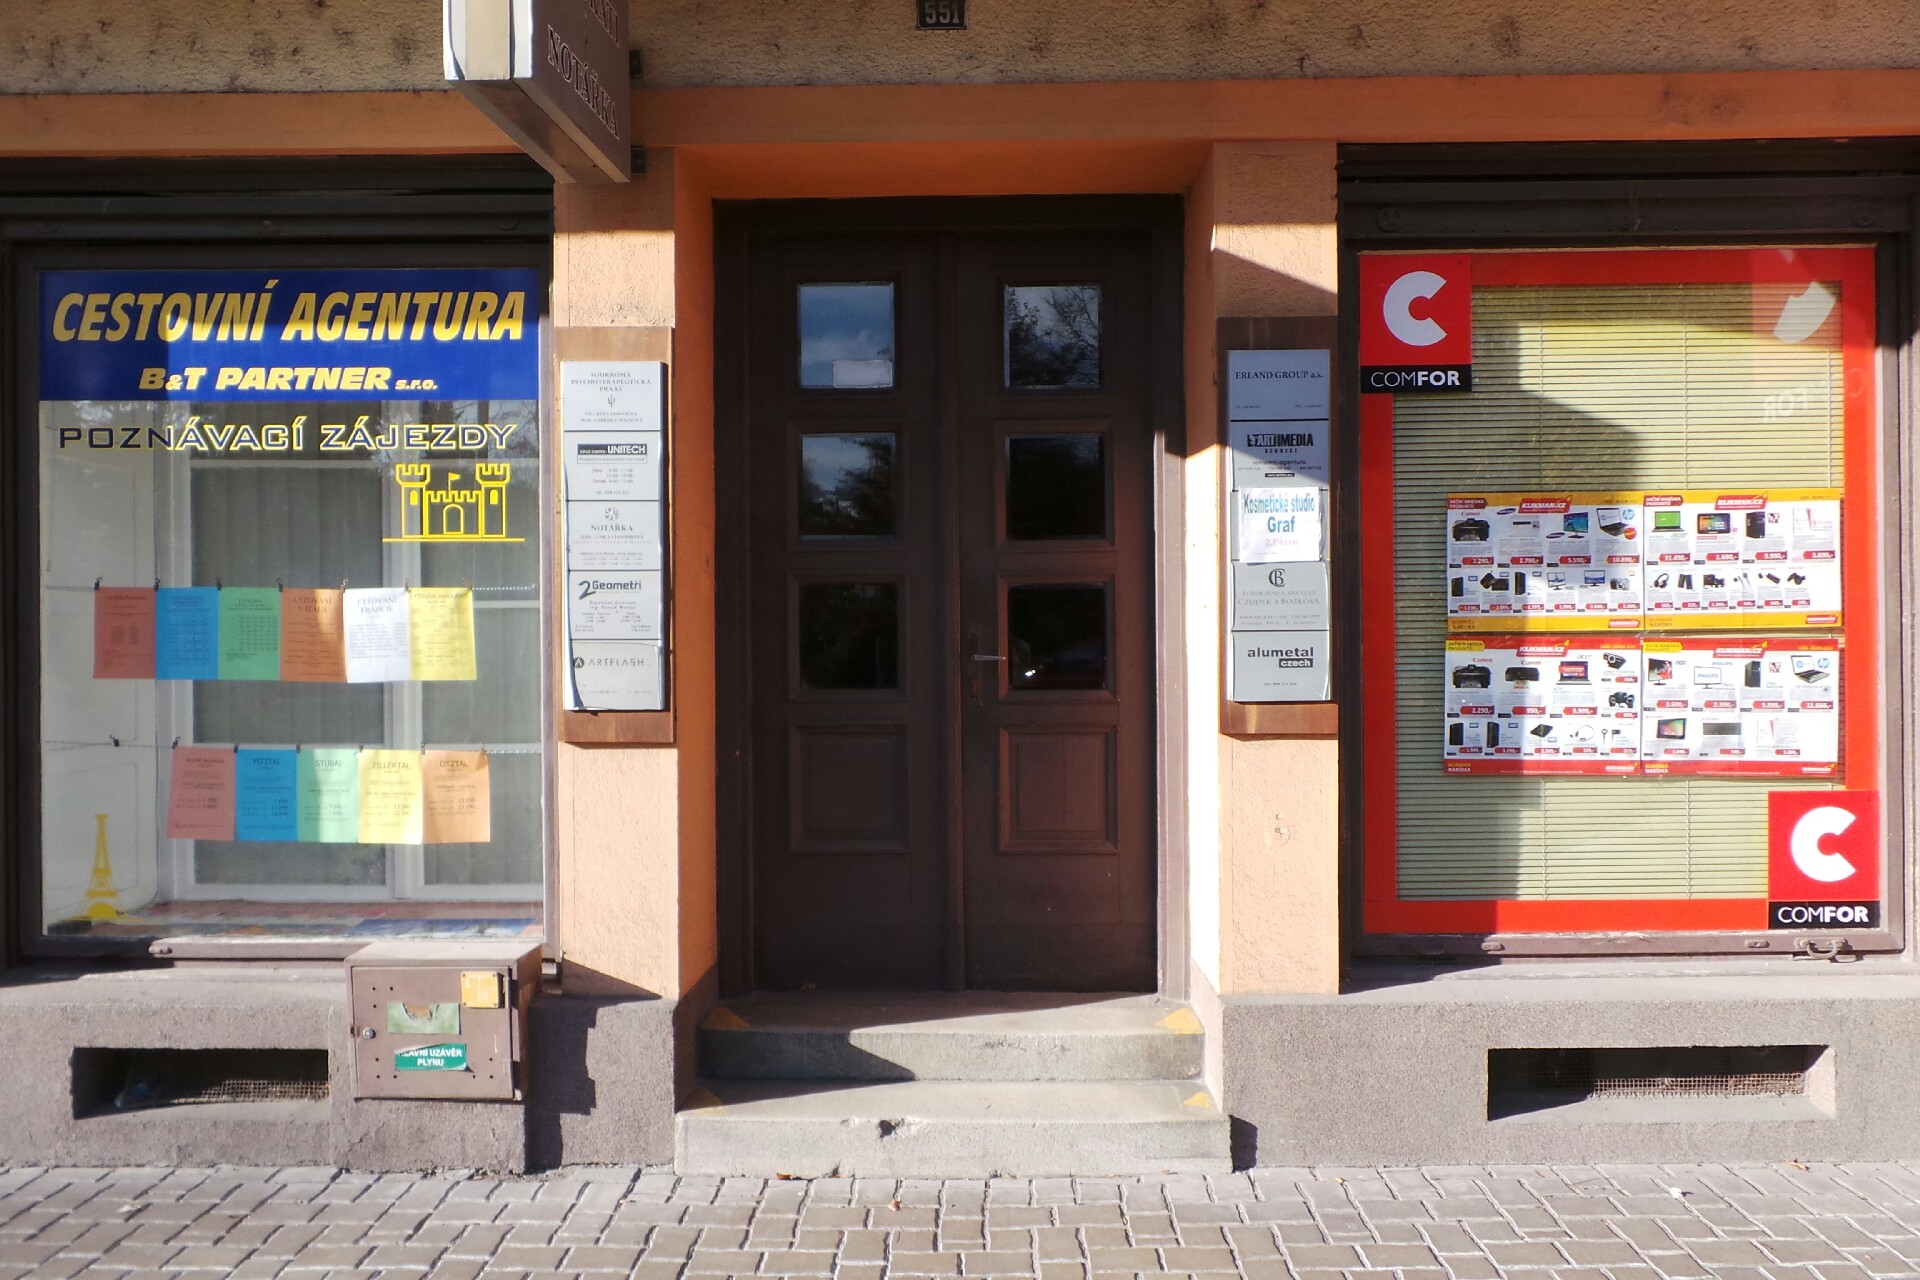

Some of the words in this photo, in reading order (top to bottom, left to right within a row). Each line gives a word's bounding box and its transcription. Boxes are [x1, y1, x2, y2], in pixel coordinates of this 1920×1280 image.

[924, 0, 960, 24] 551
[52, 279, 279, 342] CESTOVNÍ
[281, 291, 525, 341] AGENTURA
[138, 367, 207, 391] B&T
[214, 367, 391, 391] PARTNER
[394, 379, 438, 390] s.r.o.
[1235, 371, 1274, 380] ERLAND
[1274, 371, 1309, 379] GROUP
[1370, 371, 1461, 387] COMFOR
[59, 416, 307, 451] POZNÁVACÍ
[320, 416, 517, 451] ZÁJEZDY
[607, 445, 646, 454] UNITECH
[1243, 493, 1289, 513] Kosmetické
[1291, 493, 1315, 513] studio
[1267, 516, 1296, 533] Graf
[1247, 647, 1314, 658] alumetal
[588, 658, 644, 667] ARTFLASH
[1280, 659, 1311, 667] czech
[371, 761, 411, 769] ZILLERTAL
[1777, 906, 1869, 923] COMFOR
[417, 1058, 444, 1066] PLYNU
